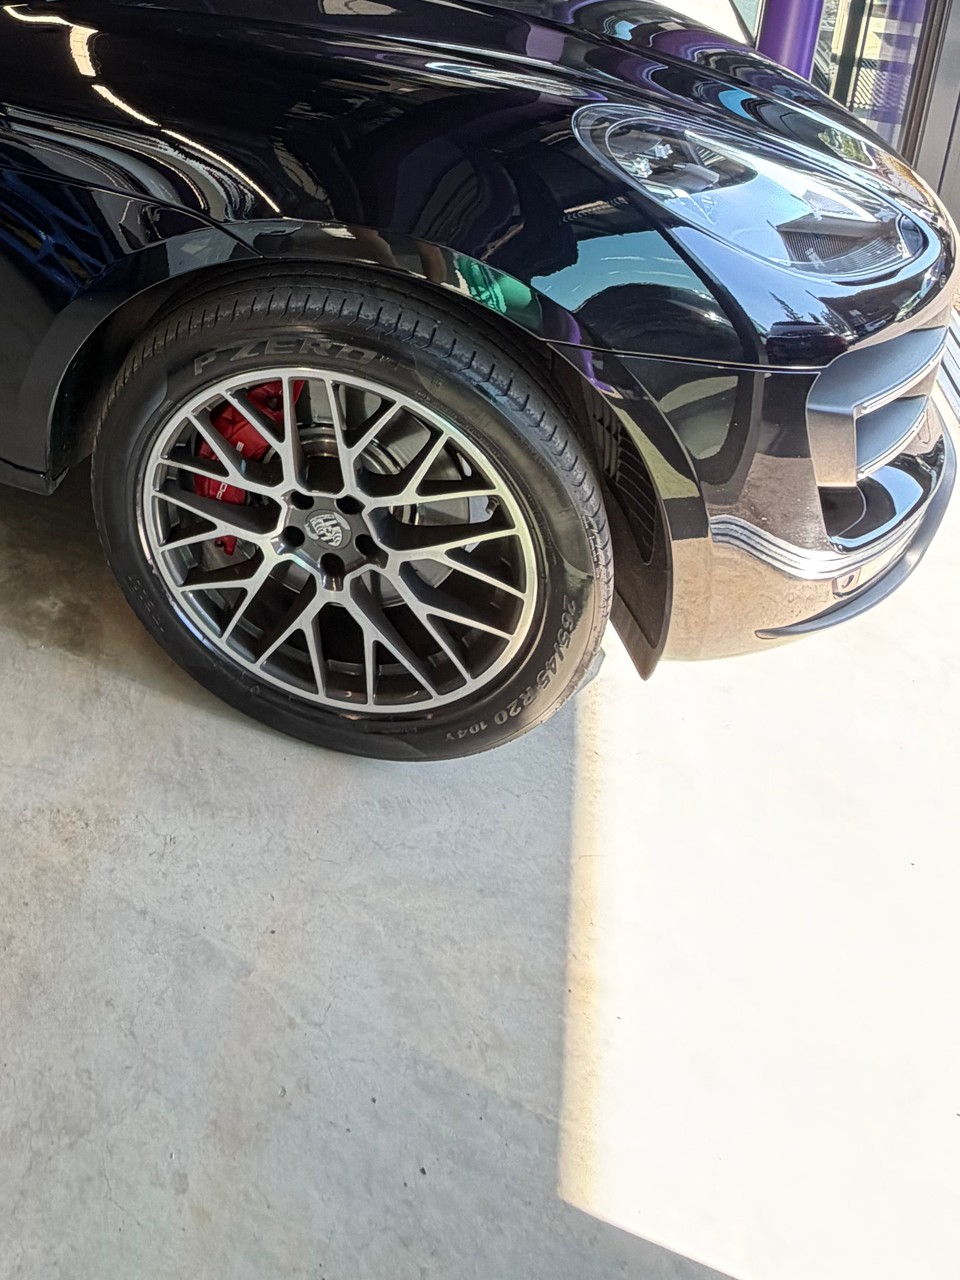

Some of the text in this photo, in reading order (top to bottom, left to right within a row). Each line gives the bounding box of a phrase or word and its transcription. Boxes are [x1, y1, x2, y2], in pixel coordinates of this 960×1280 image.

[222, 336, 378, 365] ZERO
[537, 594, 577, 690] 265/45
[444, 721, 488, 742] 104Y
